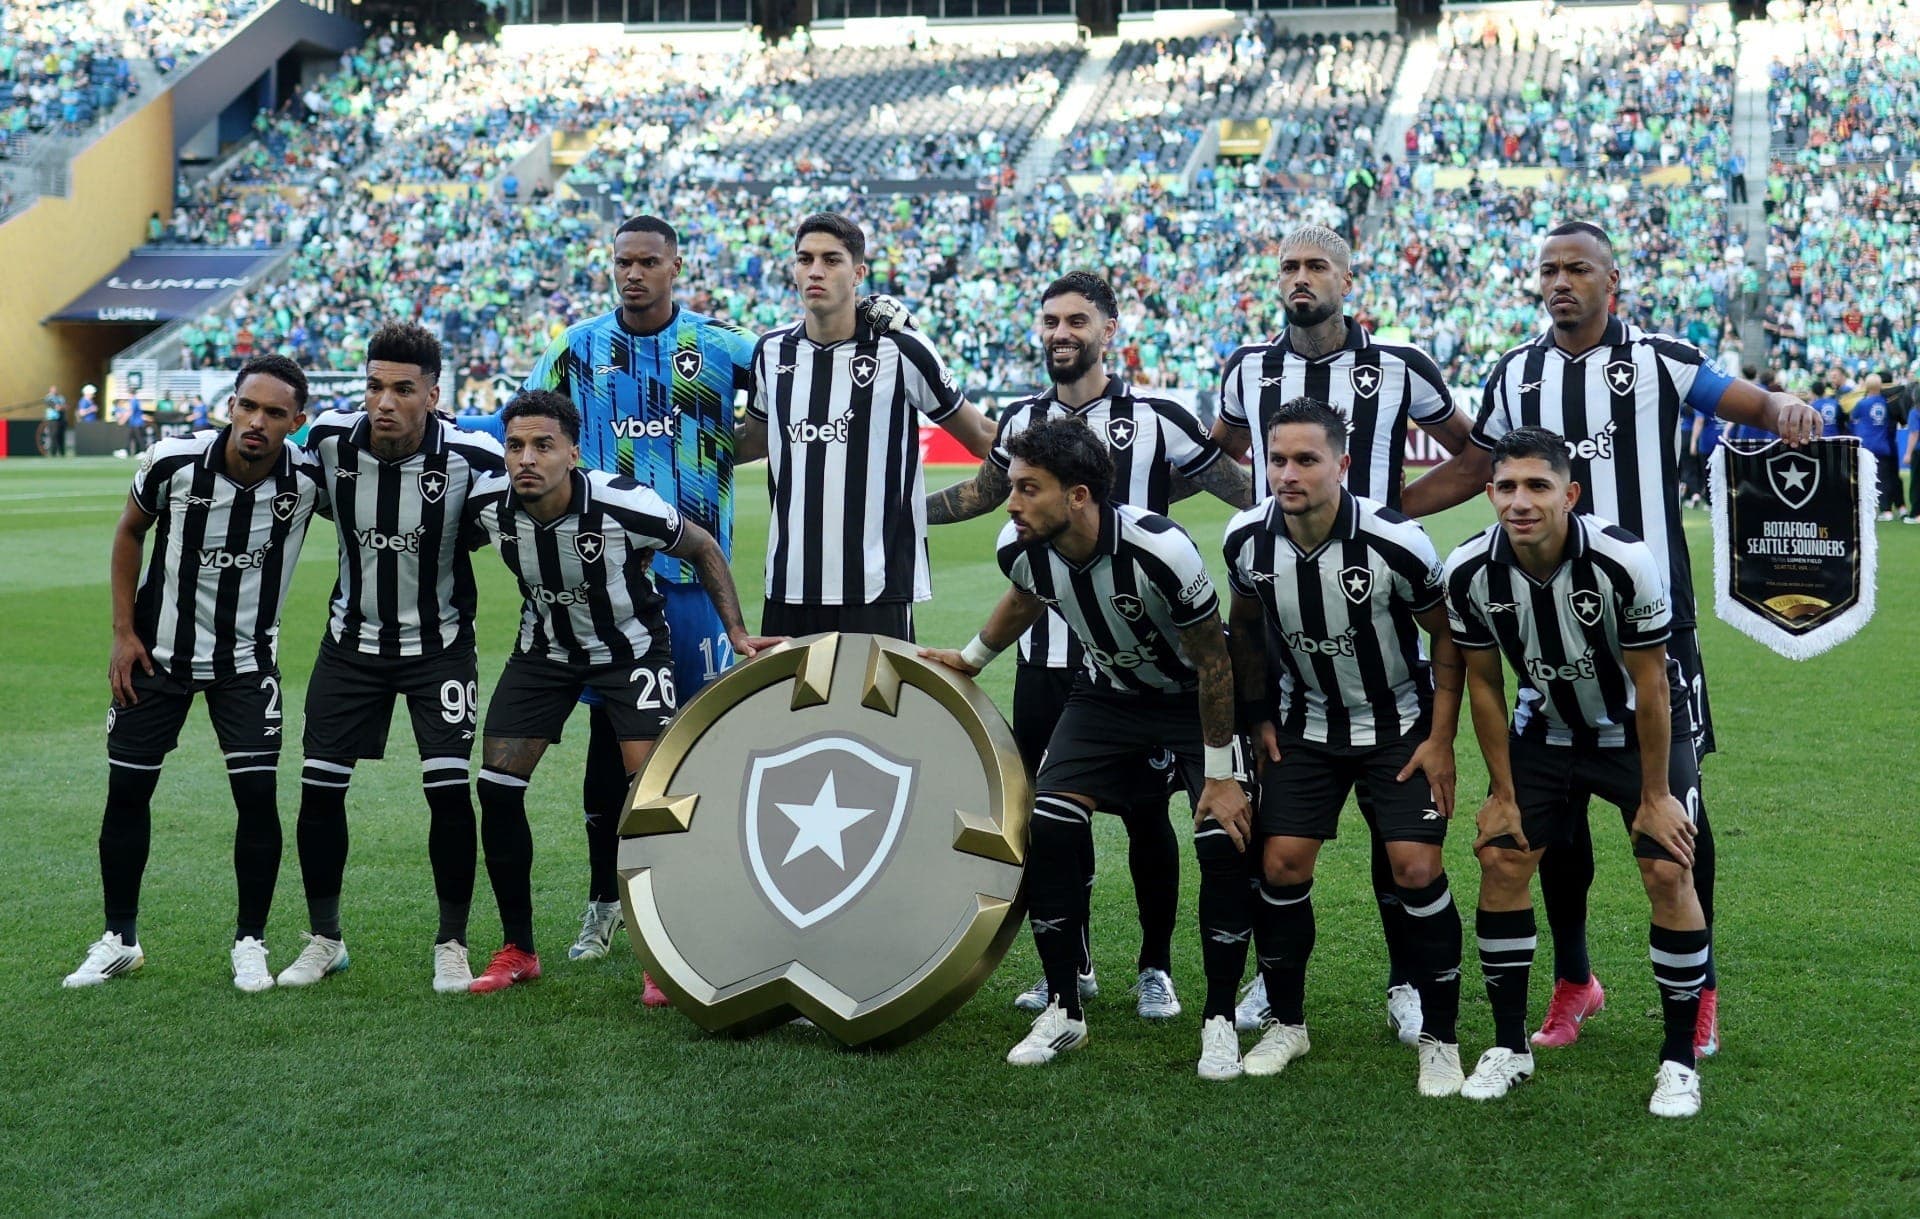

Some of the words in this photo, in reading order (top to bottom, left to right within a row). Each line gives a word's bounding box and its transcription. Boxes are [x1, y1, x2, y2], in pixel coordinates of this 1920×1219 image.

[107, 277, 249, 290] LUMEN
[98, 307, 157, 321] LUMEN
[610, 415, 674, 438] vbet
[786, 419, 846, 442] vbet
[353, 528, 418, 553] vbet
[1762, 521, 1818, 539] BOTAFOGO
[198, 549, 264, 569] vbet
[1746, 538, 1790, 554] SEATTLE
[1791, 539, 1846, 557] SOUNDERS
[526, 583, 586, 605] vbet
[1281, 631, 1354, 656] vbet
[699, 632, 733, 681] 12
[260, 676, 281, 719] 2
[629, 667, 676, 710] 26
[440, 679, 477, 724] 99
